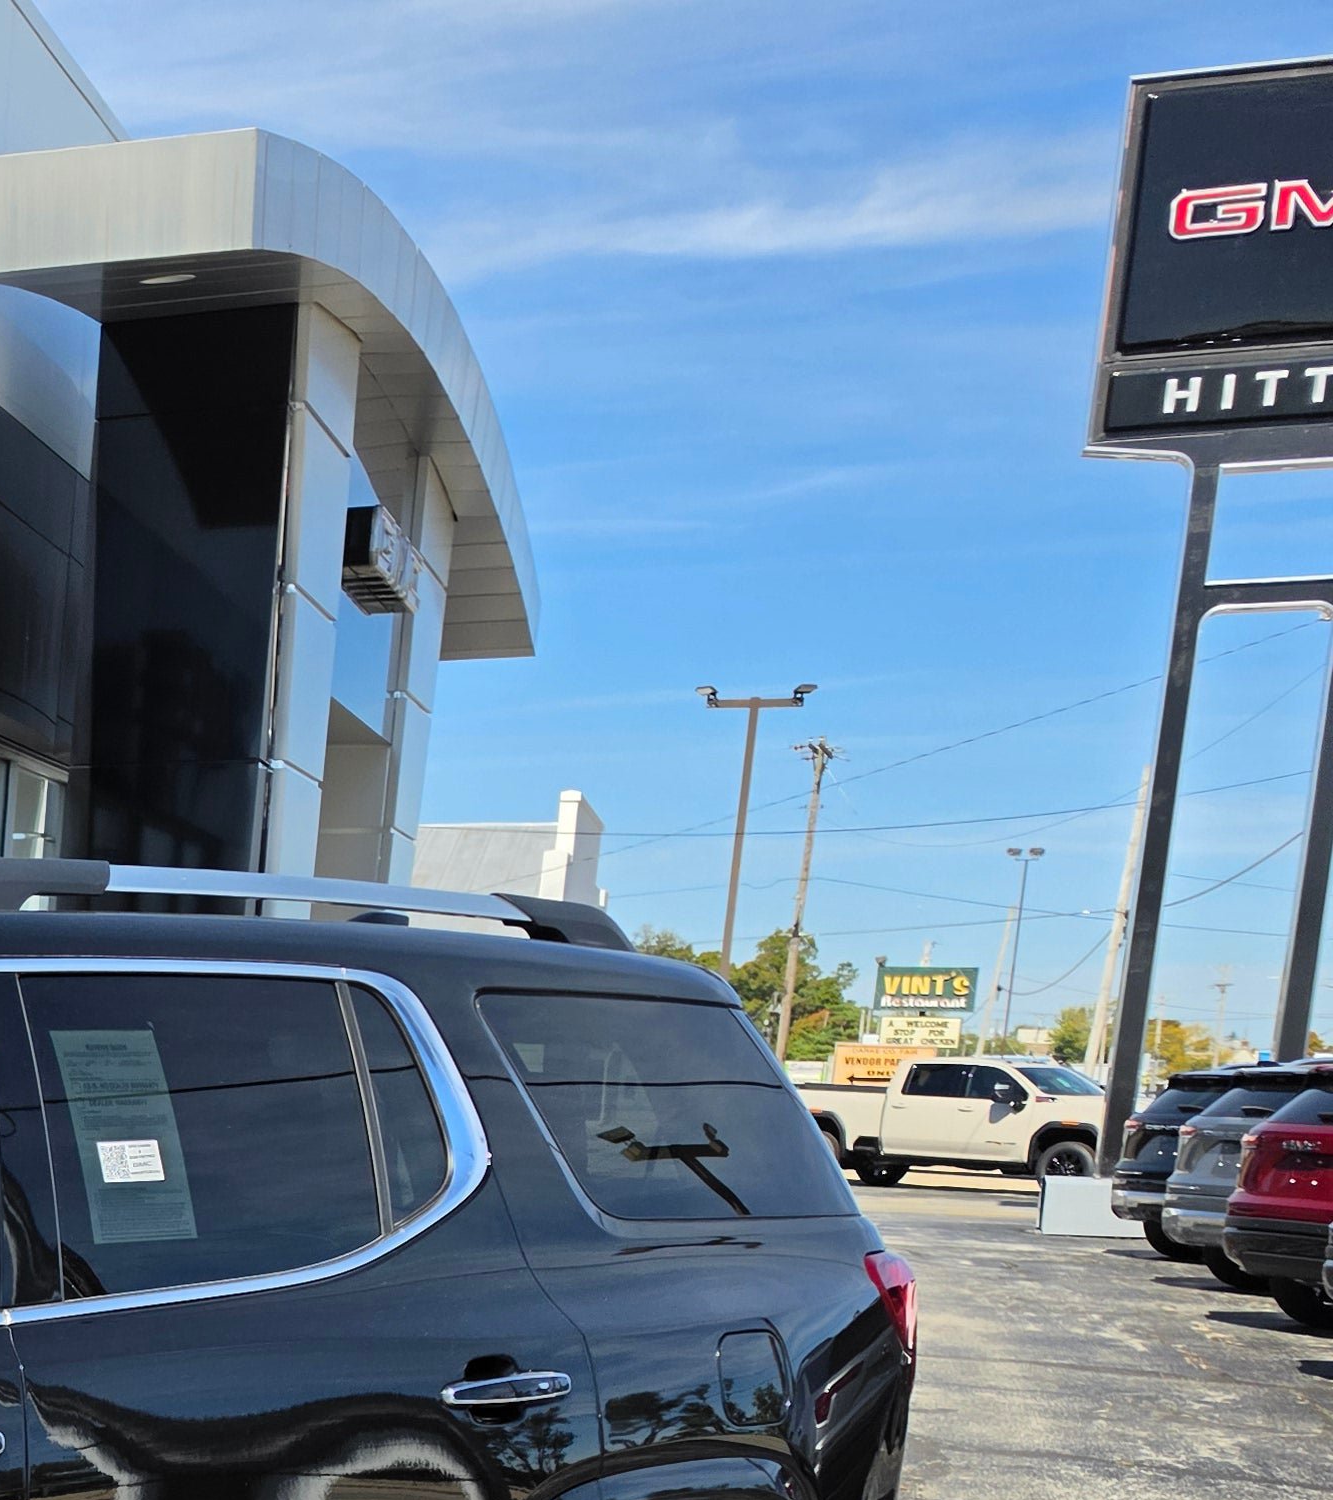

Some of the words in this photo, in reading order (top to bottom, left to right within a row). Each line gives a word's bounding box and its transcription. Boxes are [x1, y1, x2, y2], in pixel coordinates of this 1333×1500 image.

[1162, 365, 1333, 414] HITT
[884, 971, 970, 996] VINT'S
[881, 995, 967, 1008] Restaurant
[887, 1020, 894, 1028] A
[906, 1020, 949, 1029] WELCOME
[893, 1029, 915, 1037] STOP
[844, 1057, 881, 1066] VENDOR
